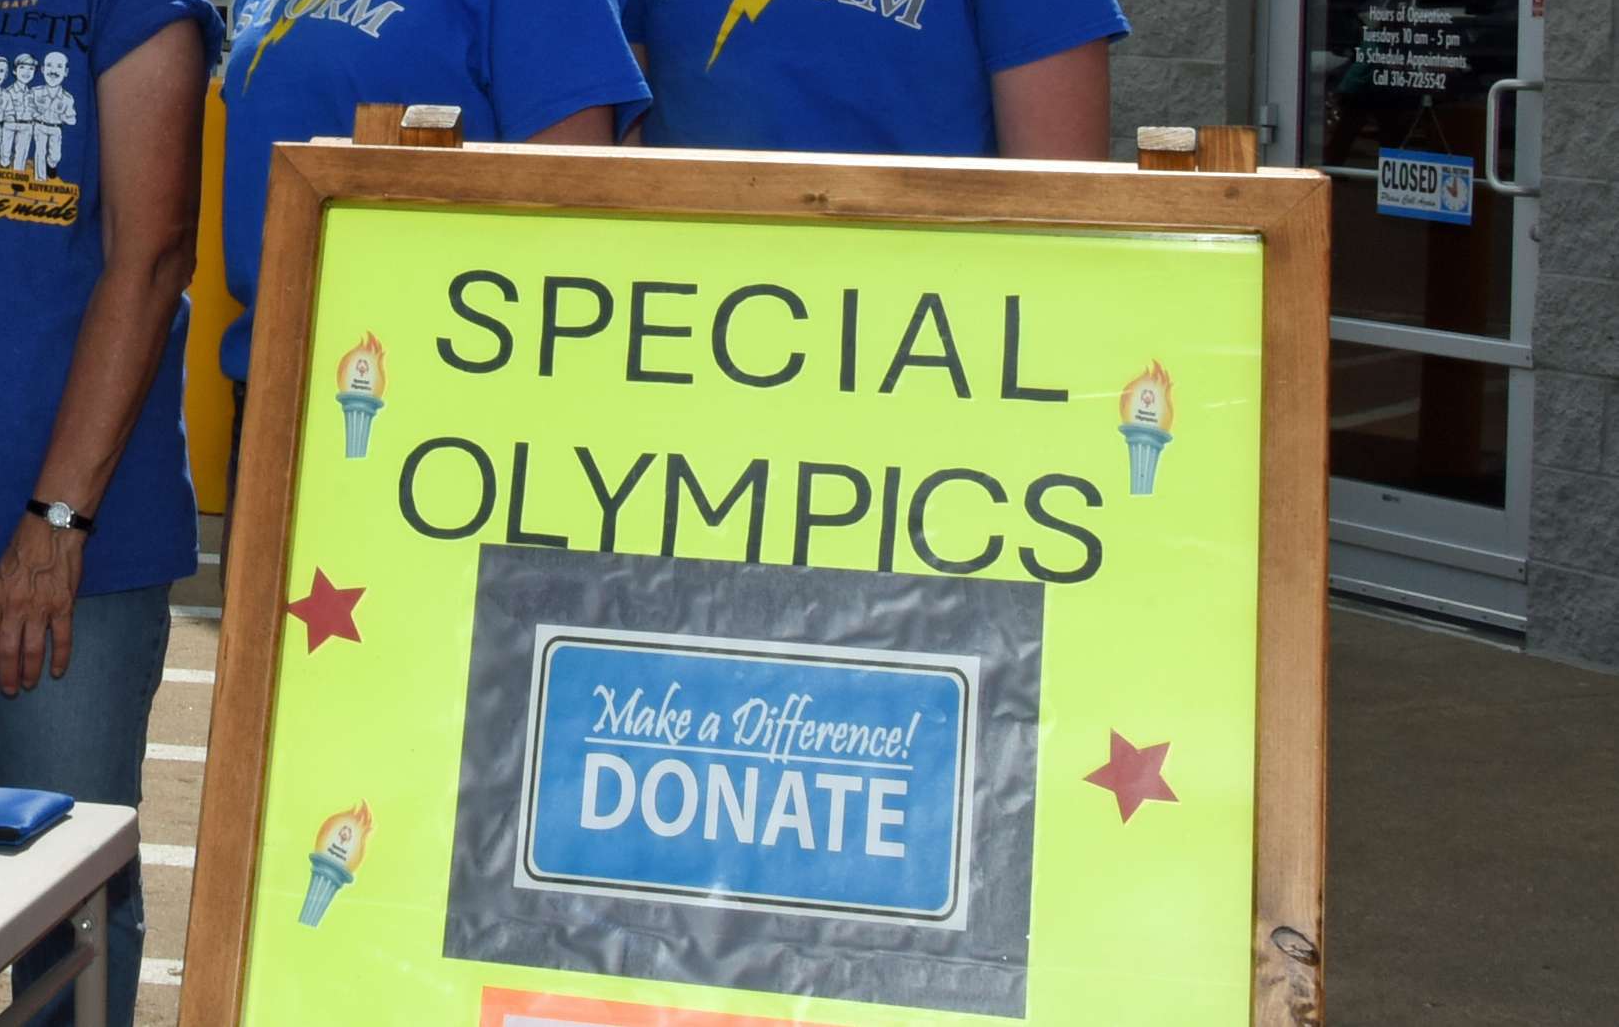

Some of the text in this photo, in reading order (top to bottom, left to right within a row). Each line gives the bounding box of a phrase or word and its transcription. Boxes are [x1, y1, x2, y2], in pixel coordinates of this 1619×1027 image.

[1369, 6, 1394, 21] Hours
[1396, 5, 1406, 20] of
[0, 12, 90, 53] LETR
[1362, 26, 1400, 45] Tuesdays
[1403, 28, 1412, 43] 10
[1414, 33, 1428, 44] am
[1437, 30, 1443, 45] 5
[1446, 34, 1460, 48] pm
[1355, 47, 1364, 63] To
[1366, 48, 1404, 65] Schedule
[1373, 69, 1388, 86] Call
[1382, 160, 1437, 194] CLOSED
[12, 196, 77, 221] made
[436, 269, 1069, 403] SPECIAL
[398, 437, 1104, 585] OLYMPICS
[592, 681, 922, 764] Make a Difference!
[580, 752, 908, 858] DONATE
